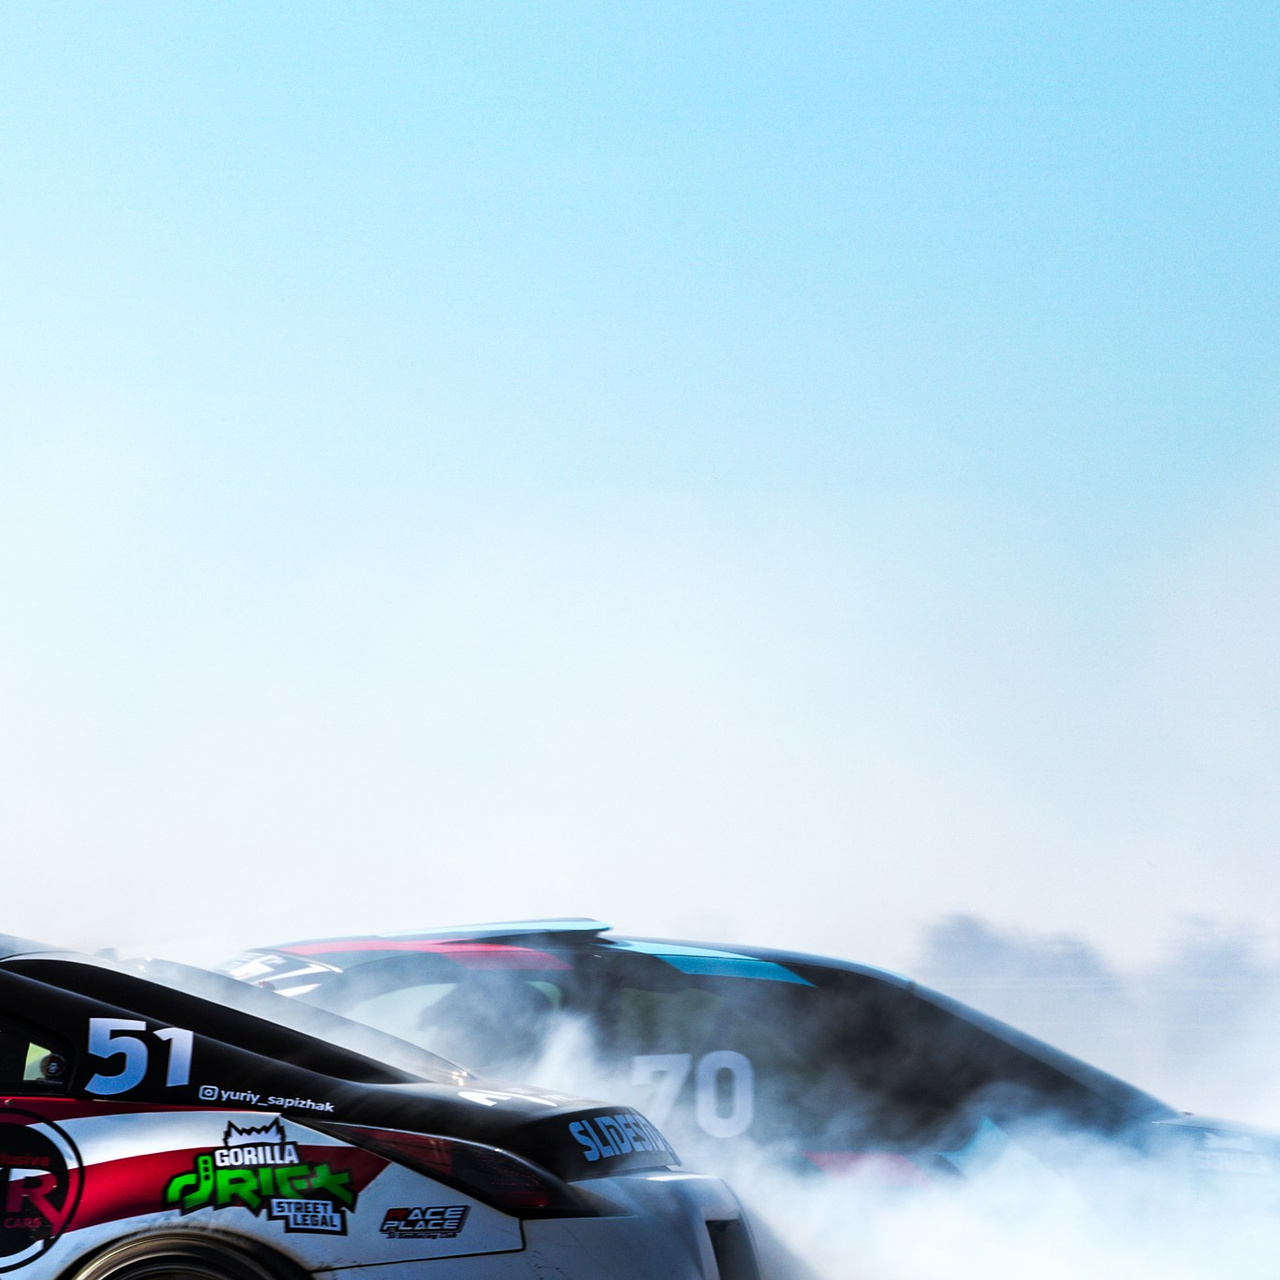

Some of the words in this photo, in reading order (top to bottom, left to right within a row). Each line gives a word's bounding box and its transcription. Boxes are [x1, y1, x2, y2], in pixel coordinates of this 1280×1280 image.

[84, 1017, 194, 1096] 51
[221, 1089, 335, 1113] yuriy_sapizhak
[631, 1050, 755, 1138] 70
[214, 1144, 299, 1167] GORILLA
[276, 1201, 330, 1214] STREET
[387, 1207, 465, 1220] RACE
[3, 1217, 43, 1229] CARS
[293, 1213, 338, 1228] LEGAL
[383, 1220, 460, 1230] PLACE
